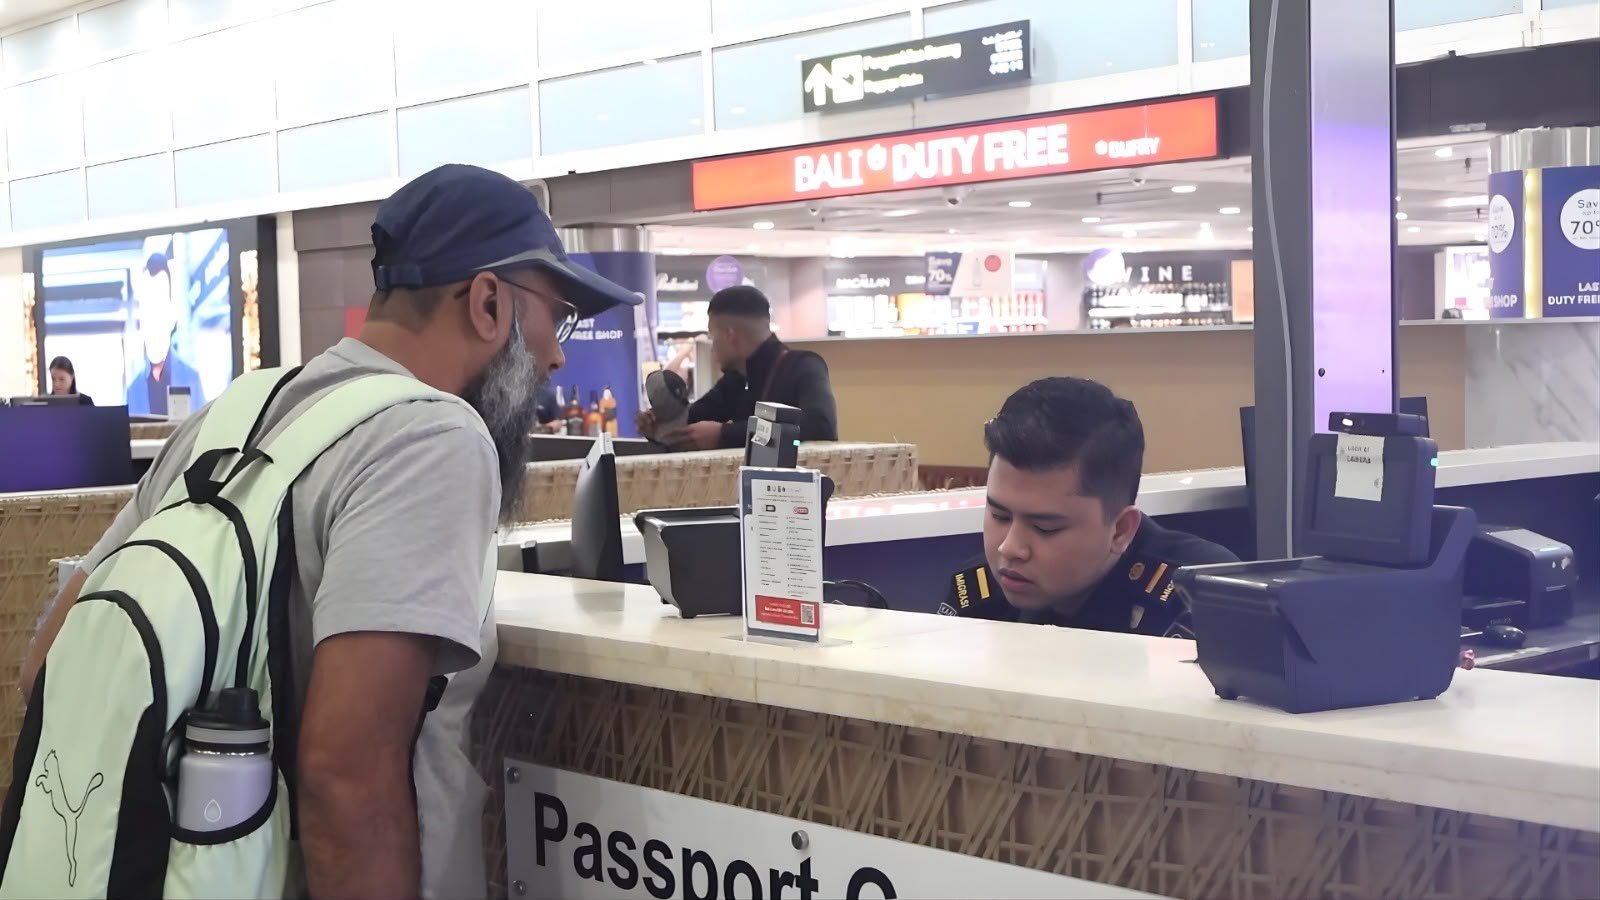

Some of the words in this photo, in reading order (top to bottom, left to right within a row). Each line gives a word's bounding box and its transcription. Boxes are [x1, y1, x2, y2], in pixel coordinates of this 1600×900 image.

[794, 148, 864, 192] BALI
[891, 134, 979, 183] DUTY
[983, 123, 1068, 172] FREE
[1577, 199, 1599, 209] Sav
[1578, 282, 1600, 292] LAS
[1547, 295, 1576, 305] DUTY
[576, 317, 595, 328] AST
[955, 573, 970, 609] IMIGRASI
[1160, 579, 1174, 602] IMIG
[534, 791, 819, 900] Passport
